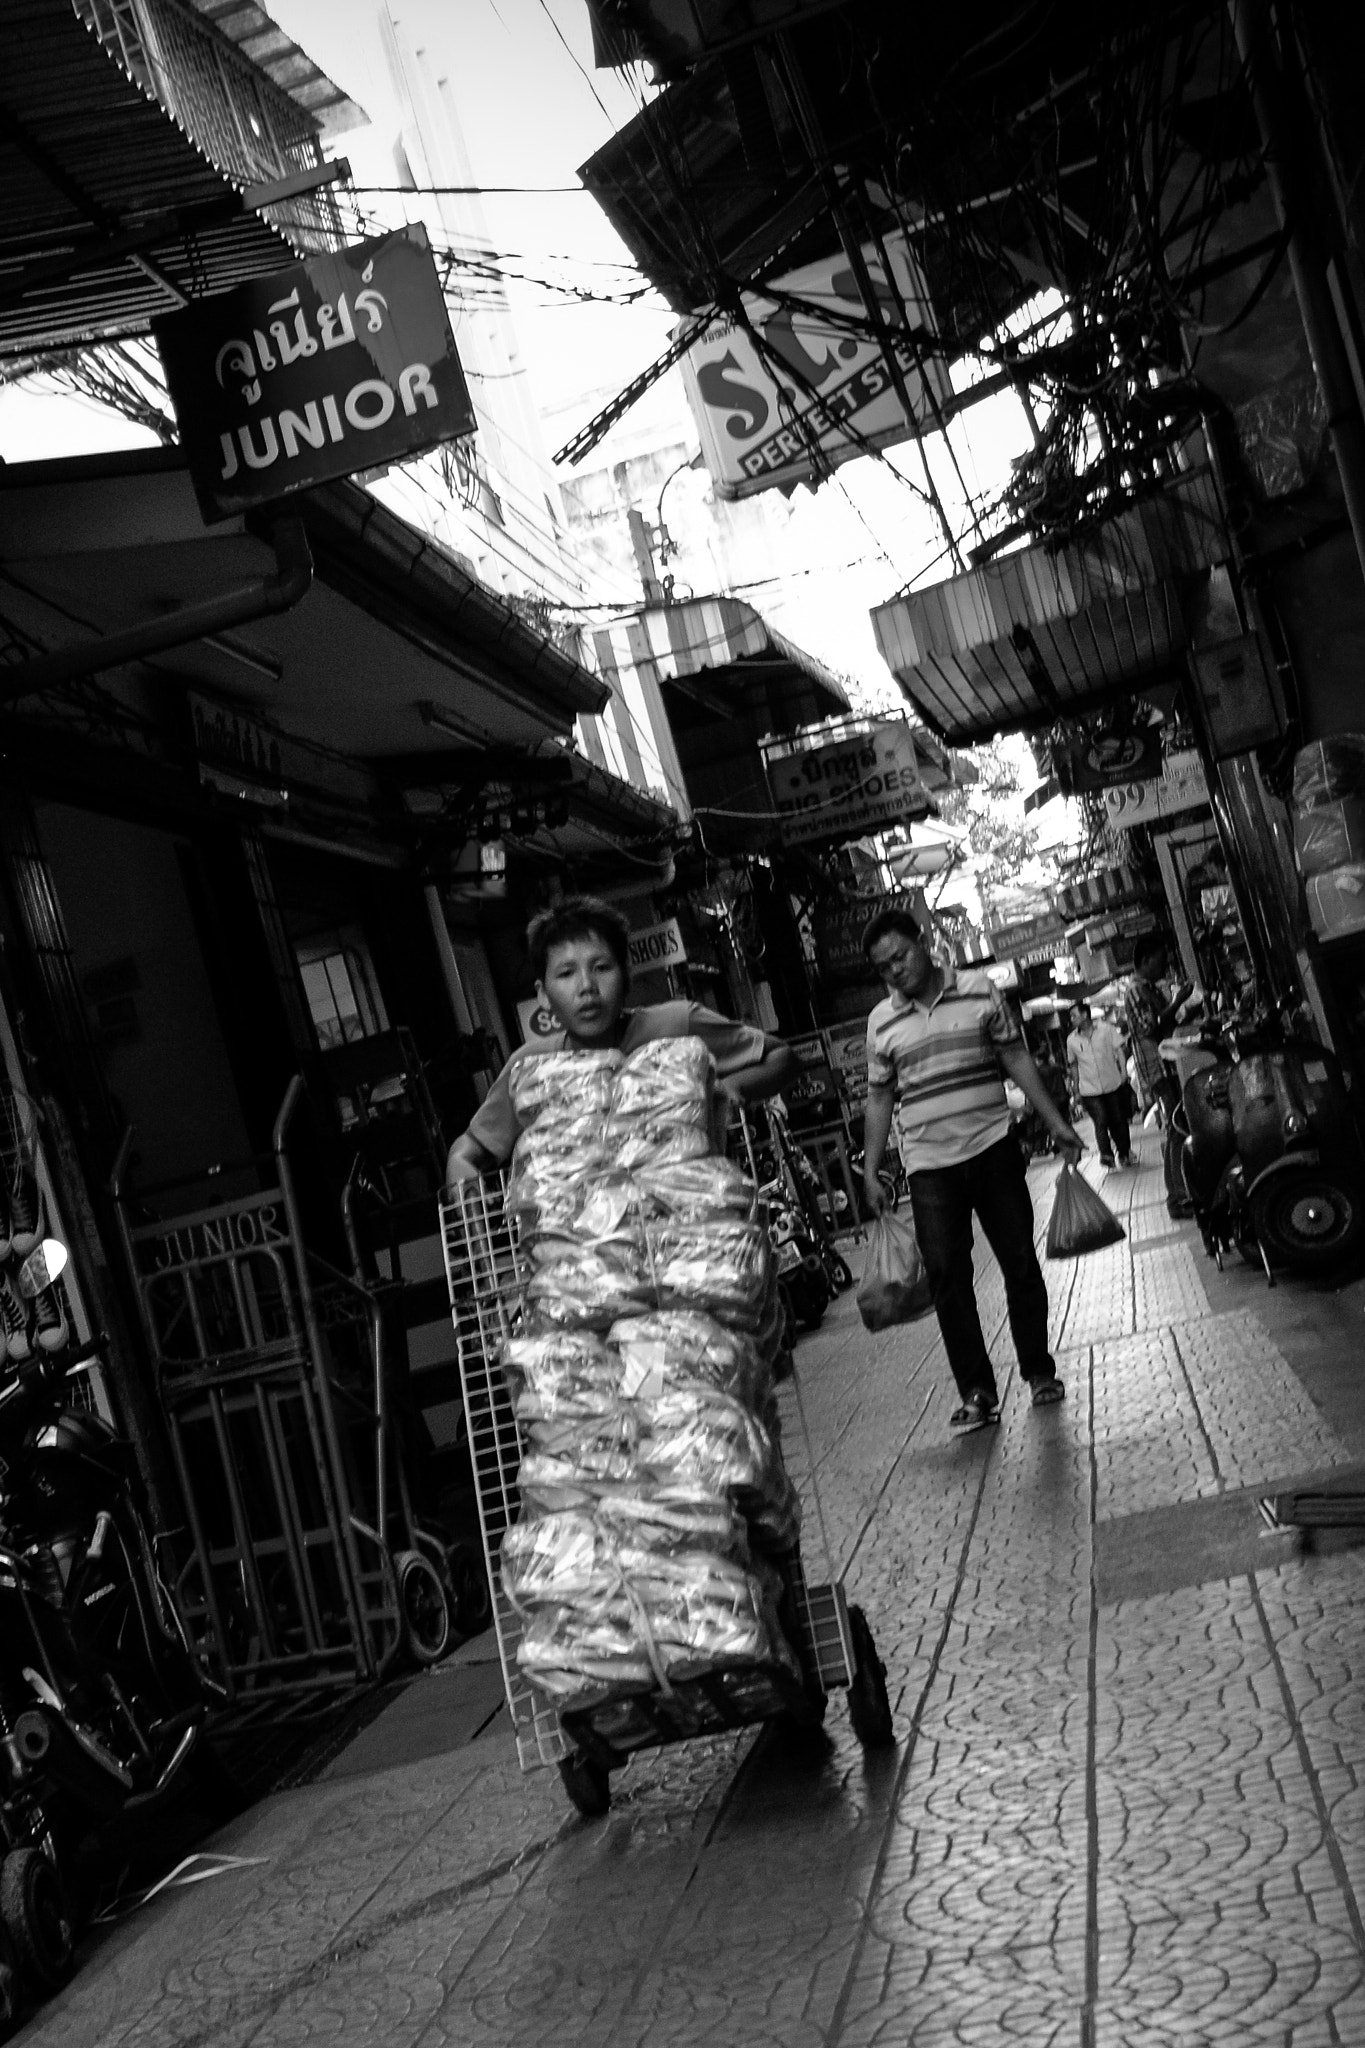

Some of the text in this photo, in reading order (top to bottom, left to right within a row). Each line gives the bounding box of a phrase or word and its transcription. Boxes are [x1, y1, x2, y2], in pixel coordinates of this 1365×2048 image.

[215, 258, 388, 406] จูเนียร์
[220, 363, 438, 480] JUNIOR
[829, 766, 916, 806] SHOES
[629, 929, 679, 965] SHOES
[155, 1205, 290, 1270] JUNIOR
